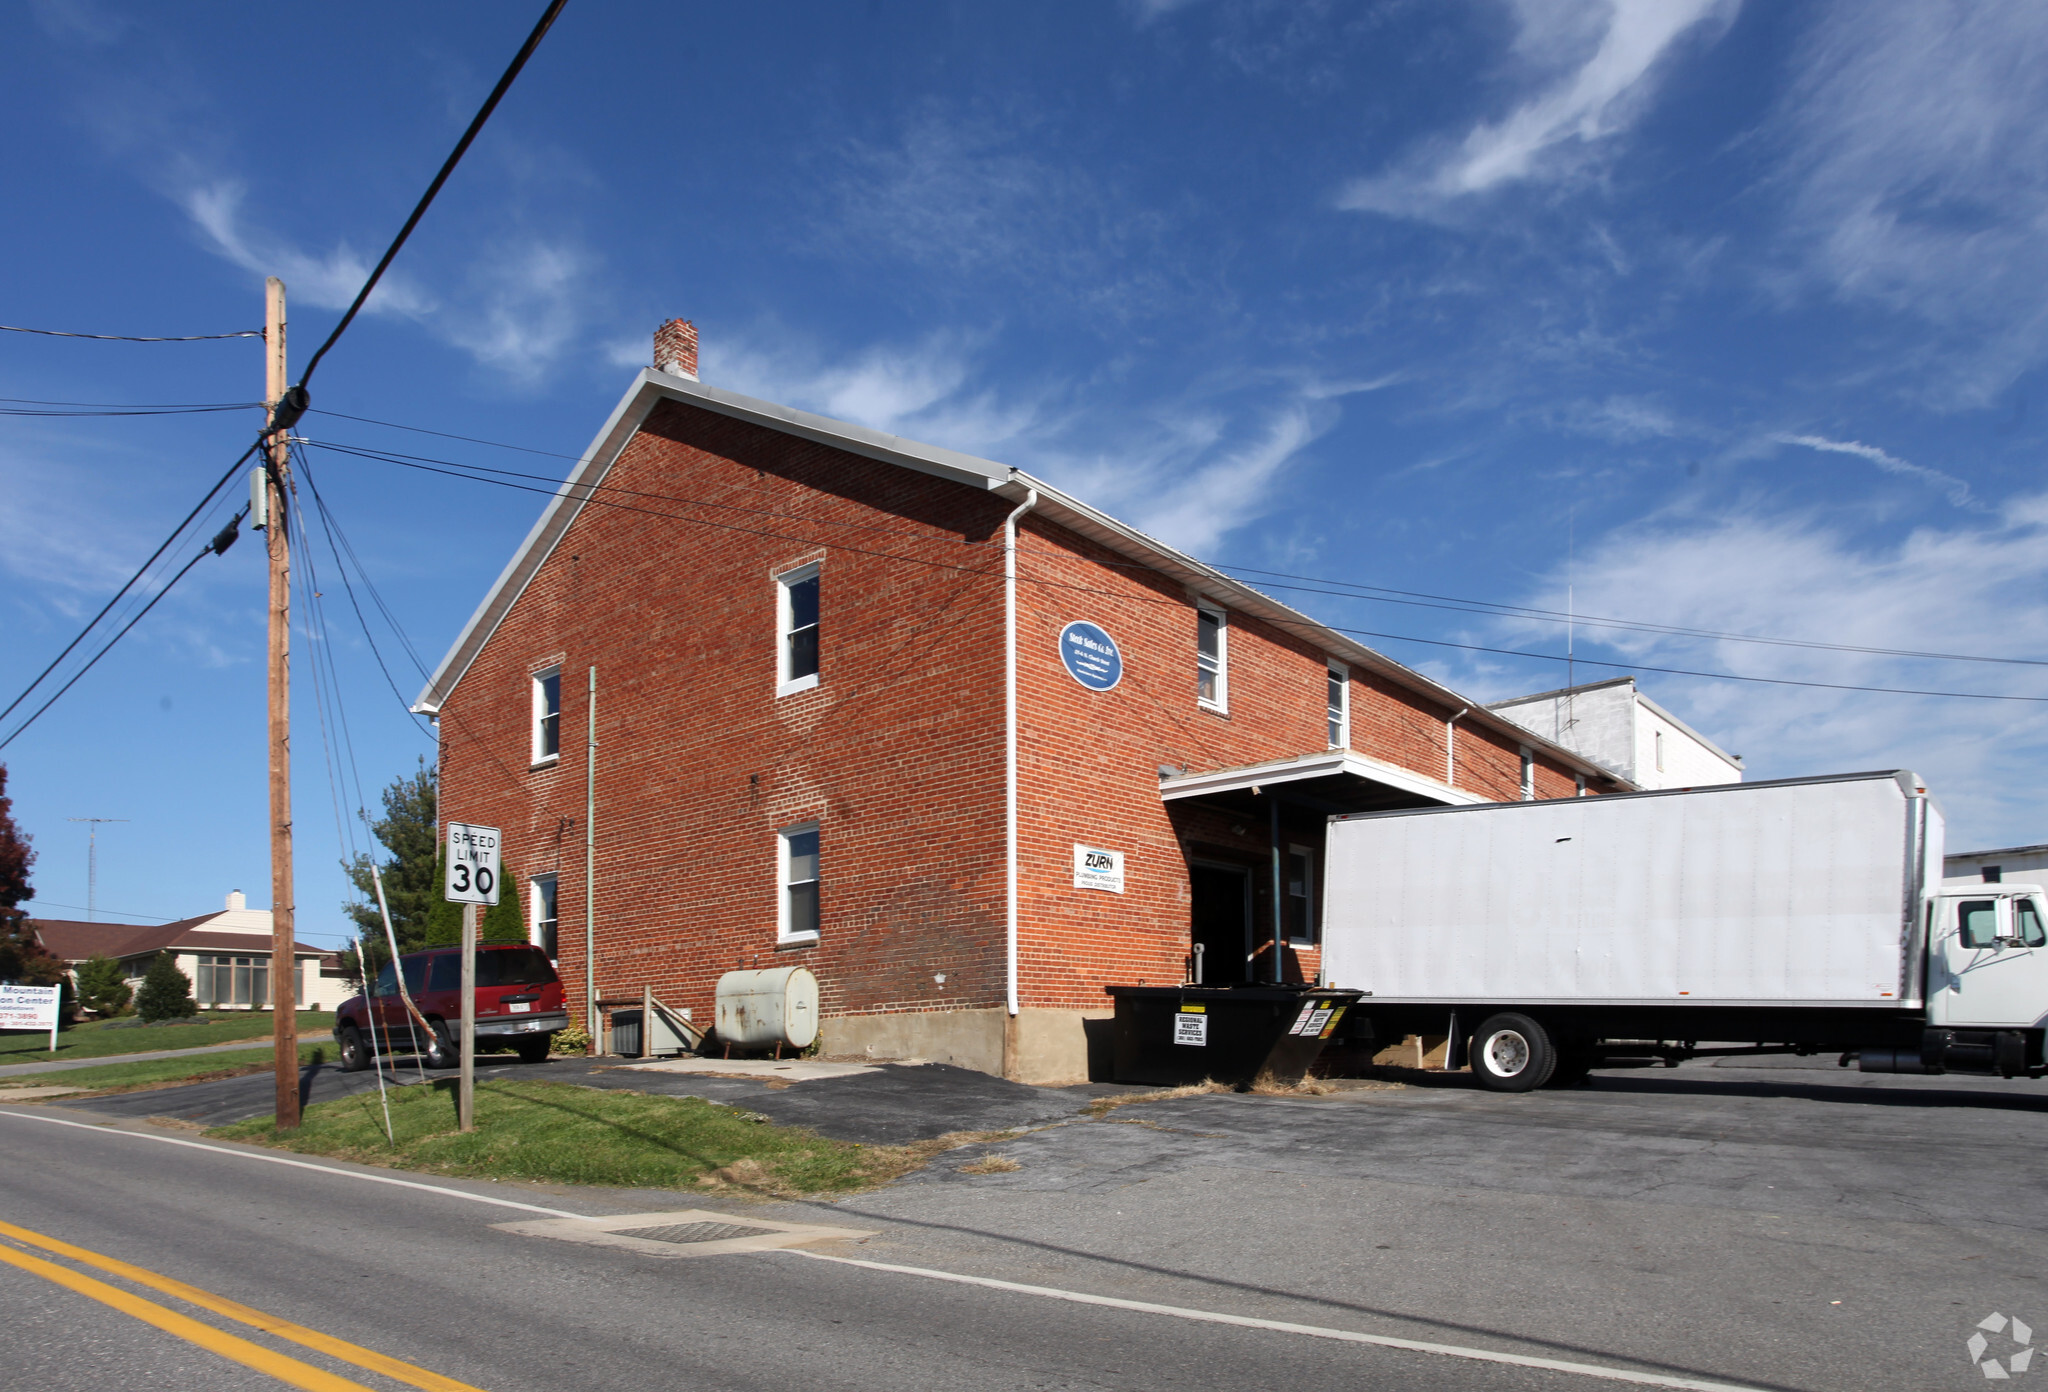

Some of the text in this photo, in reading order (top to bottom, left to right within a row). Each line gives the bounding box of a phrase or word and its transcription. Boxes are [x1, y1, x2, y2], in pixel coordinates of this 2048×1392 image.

[1083, 637, 1098, 651] Sales
[452, 832, 496, 849] SPEED
[457, 848, 490, 863] LIMIT
[1085, 853, 1114, 870] ZURN
[452, 864, 494, 895] 30
[1076, 871, 1121, 884] PLUMBING PRODUCTS
[3, 986, 54, 995] Mountain
[17, 996, 54, 1005] Center
[1178, 1016, 1203, 1024] REGIONAL
